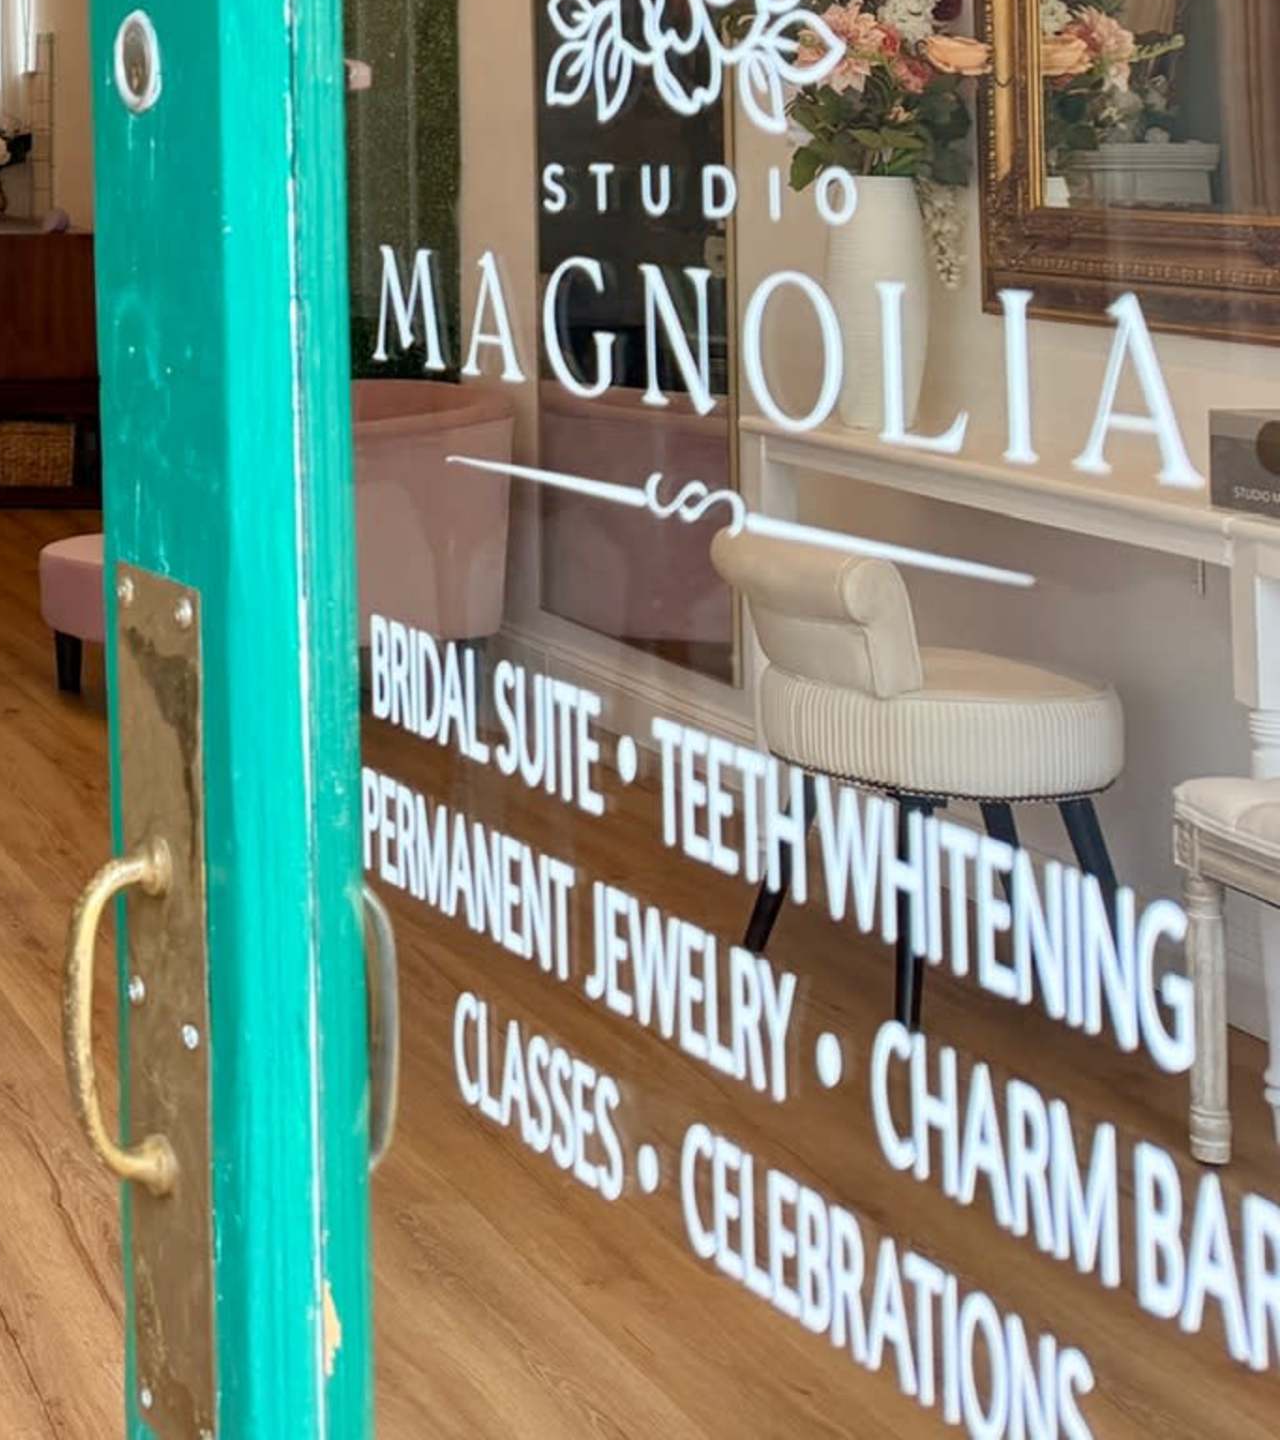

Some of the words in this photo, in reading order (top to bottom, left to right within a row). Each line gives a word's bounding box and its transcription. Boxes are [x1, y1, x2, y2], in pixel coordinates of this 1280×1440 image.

[372, 244, 1207, 490] MAGNOLIA
[542, 163, 860, 227] STUDIO
[370, 613, 490, 764] BRIDAL
[494, 659, 605, 816] SUITE
[651, 716, 808, 905] TEETH
[814, 773, 1197, 1074] WHITENING
[361, 766, 576, 981] PERMANENT
[584, 881, 798, 1103] JEWELRY
[870, 1019, 1122, 1290] CHARM
[1133, 1140, 1280, 1372] BAR
[453, 991, 624, 1202] CLASSES
[680, 1122, 1096, 1440] CELEBRATIONS
